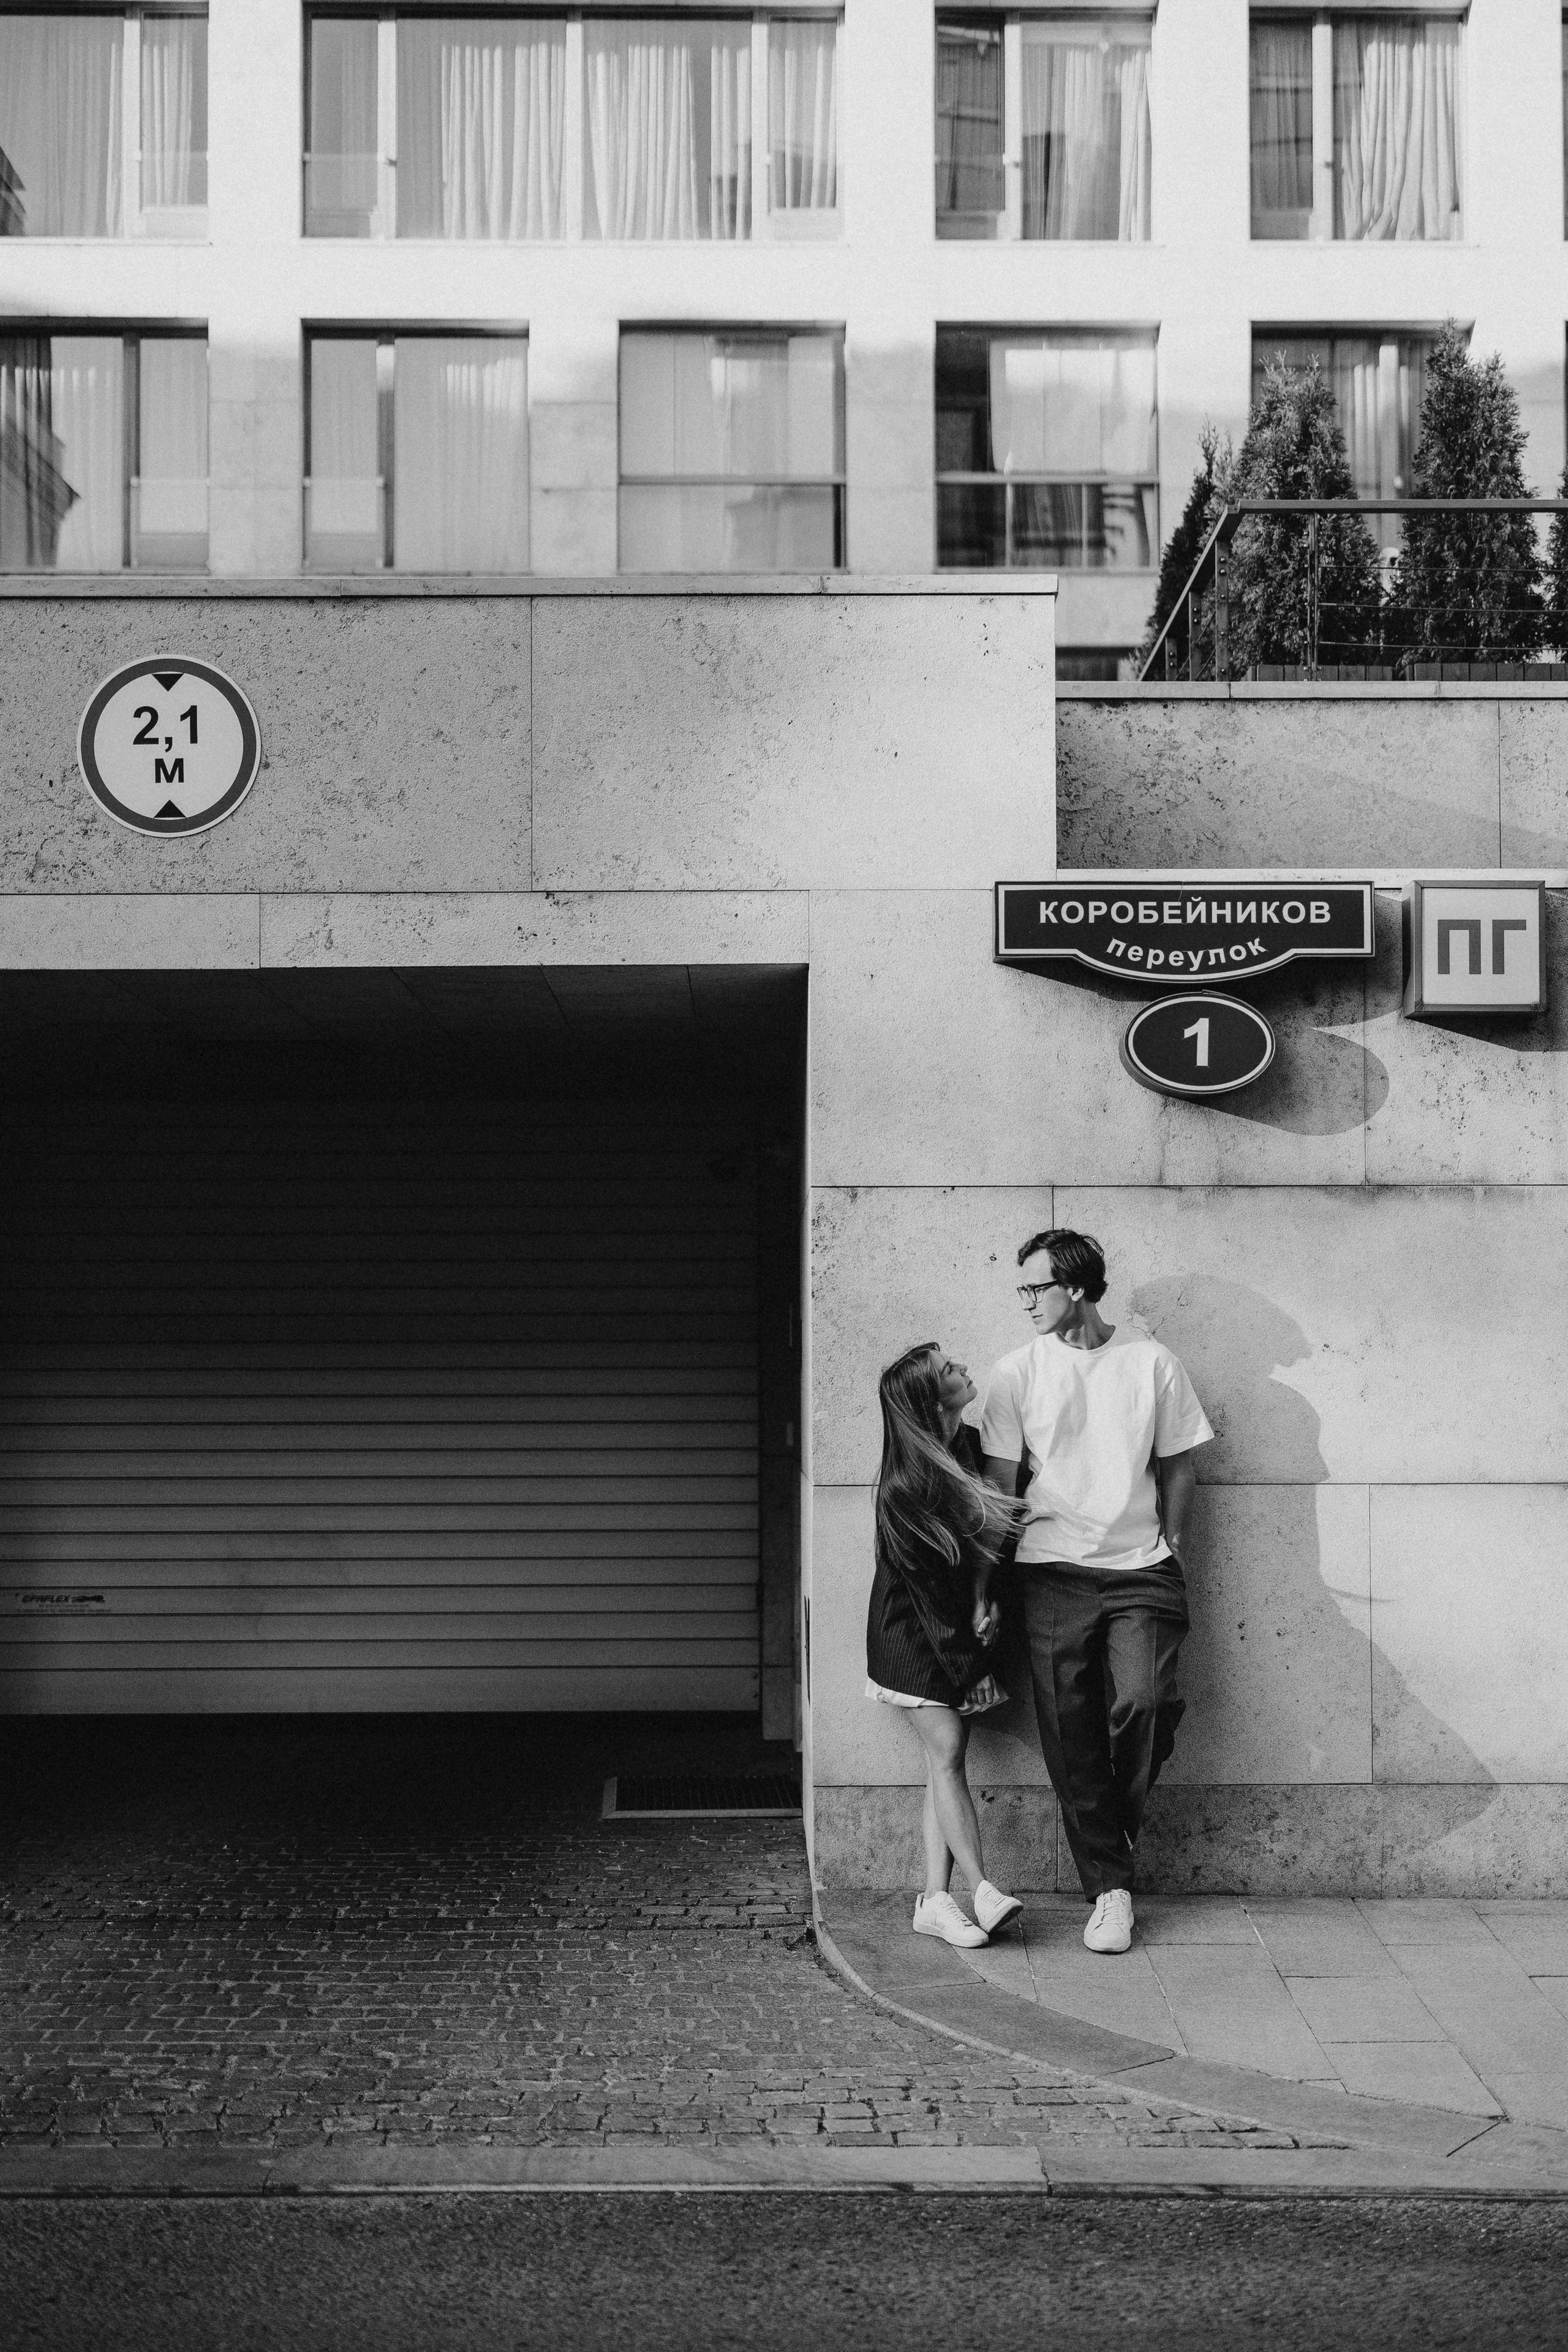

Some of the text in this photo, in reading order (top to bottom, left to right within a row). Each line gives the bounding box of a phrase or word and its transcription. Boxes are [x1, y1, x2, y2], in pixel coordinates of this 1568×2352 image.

[132, 705, 198, 753] 2,1
[154, 758, 184, 783] М
[1039, 896, 1331, 924] КОРОБЕЙНИКОВ
[1106, 937, 1268, 971] переулок
[1437, 919, 1527, 974] ПГ
[1183, 1017, 1209, 1066] 1
[22, 1594, 71, 1603] EFAFLEX
